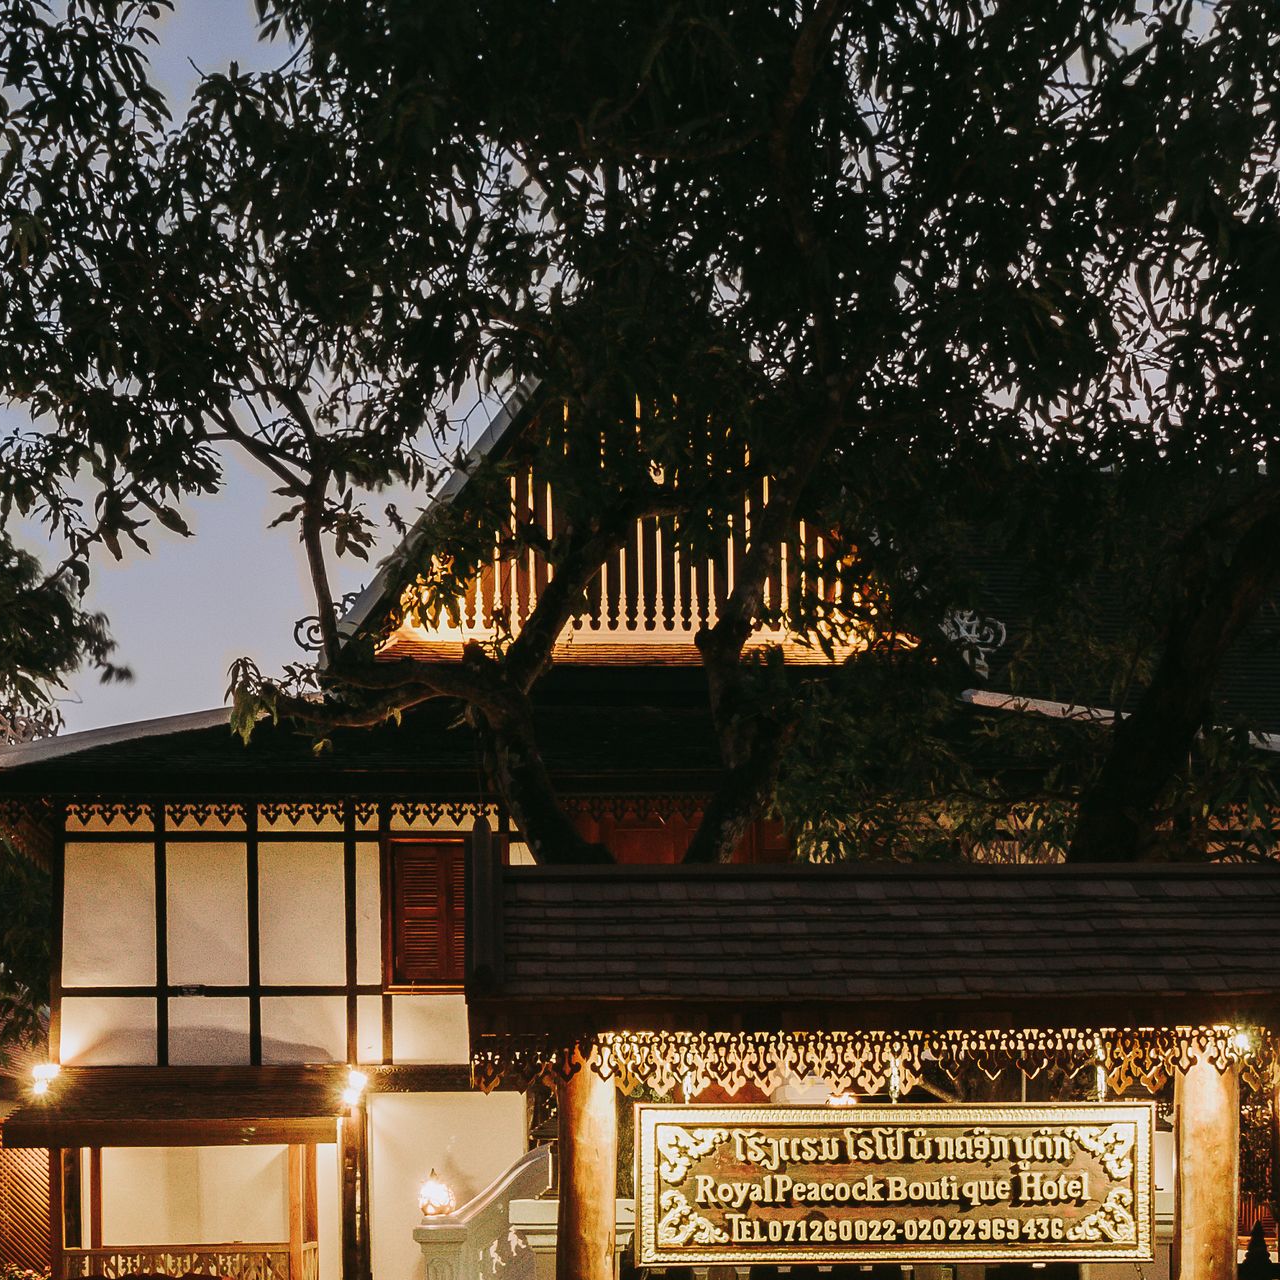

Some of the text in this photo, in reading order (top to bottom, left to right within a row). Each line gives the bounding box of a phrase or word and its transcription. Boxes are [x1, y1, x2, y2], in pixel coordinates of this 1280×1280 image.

[695, 1171, 1091, 1208] Royal Peacock Boutique Hotel
